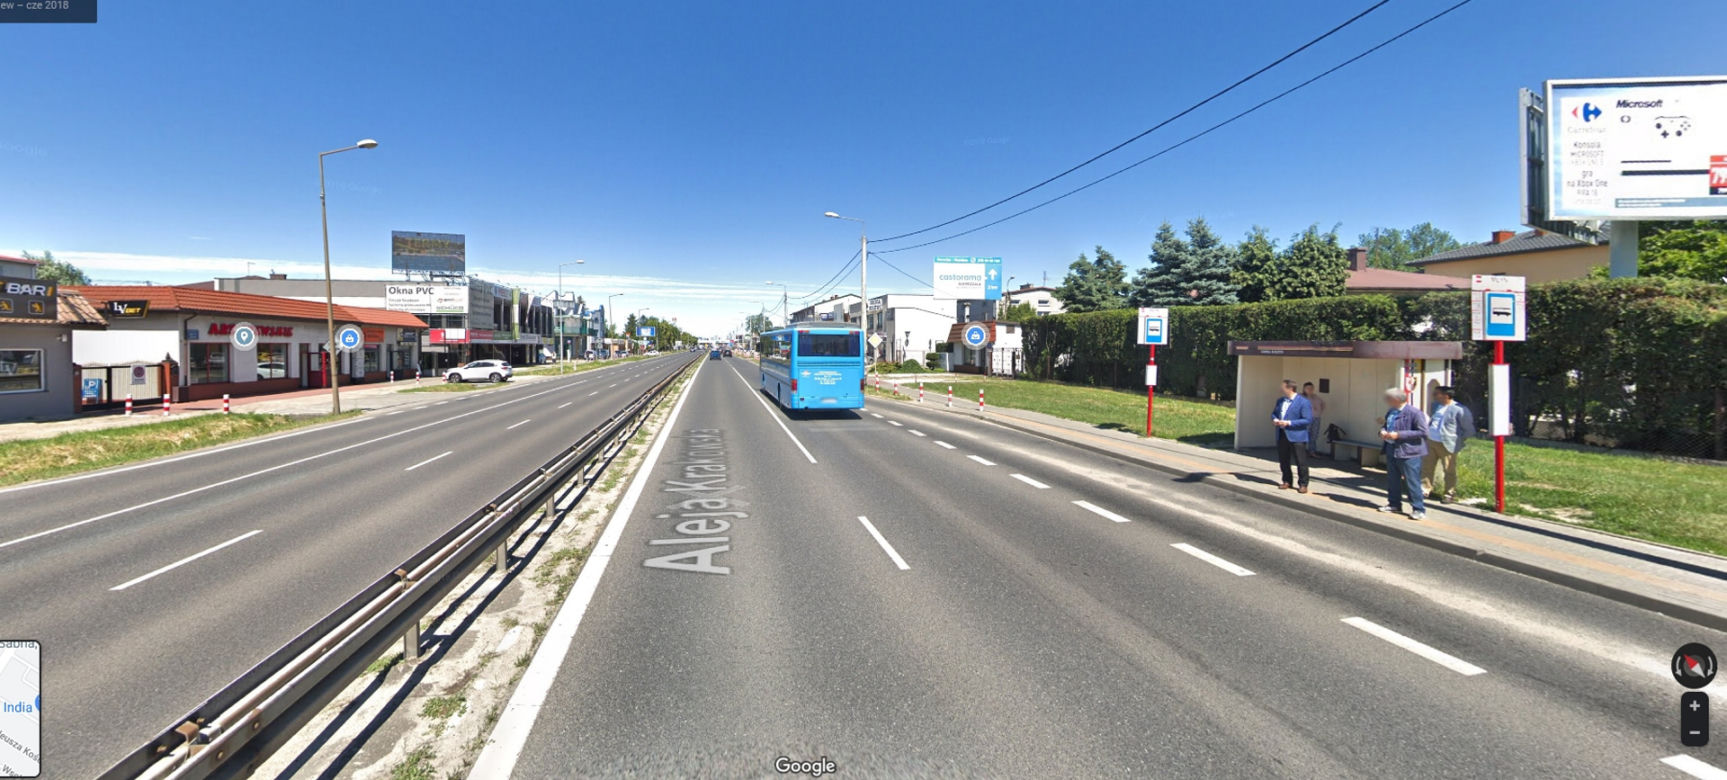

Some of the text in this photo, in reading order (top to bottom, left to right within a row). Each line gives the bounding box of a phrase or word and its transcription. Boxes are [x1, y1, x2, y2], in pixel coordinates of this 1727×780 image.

[1616, 100, 1664, 109] Microsoft
[7, 283, 46, 297] BAR
[388, 286, 434, 295] Okna PVC
